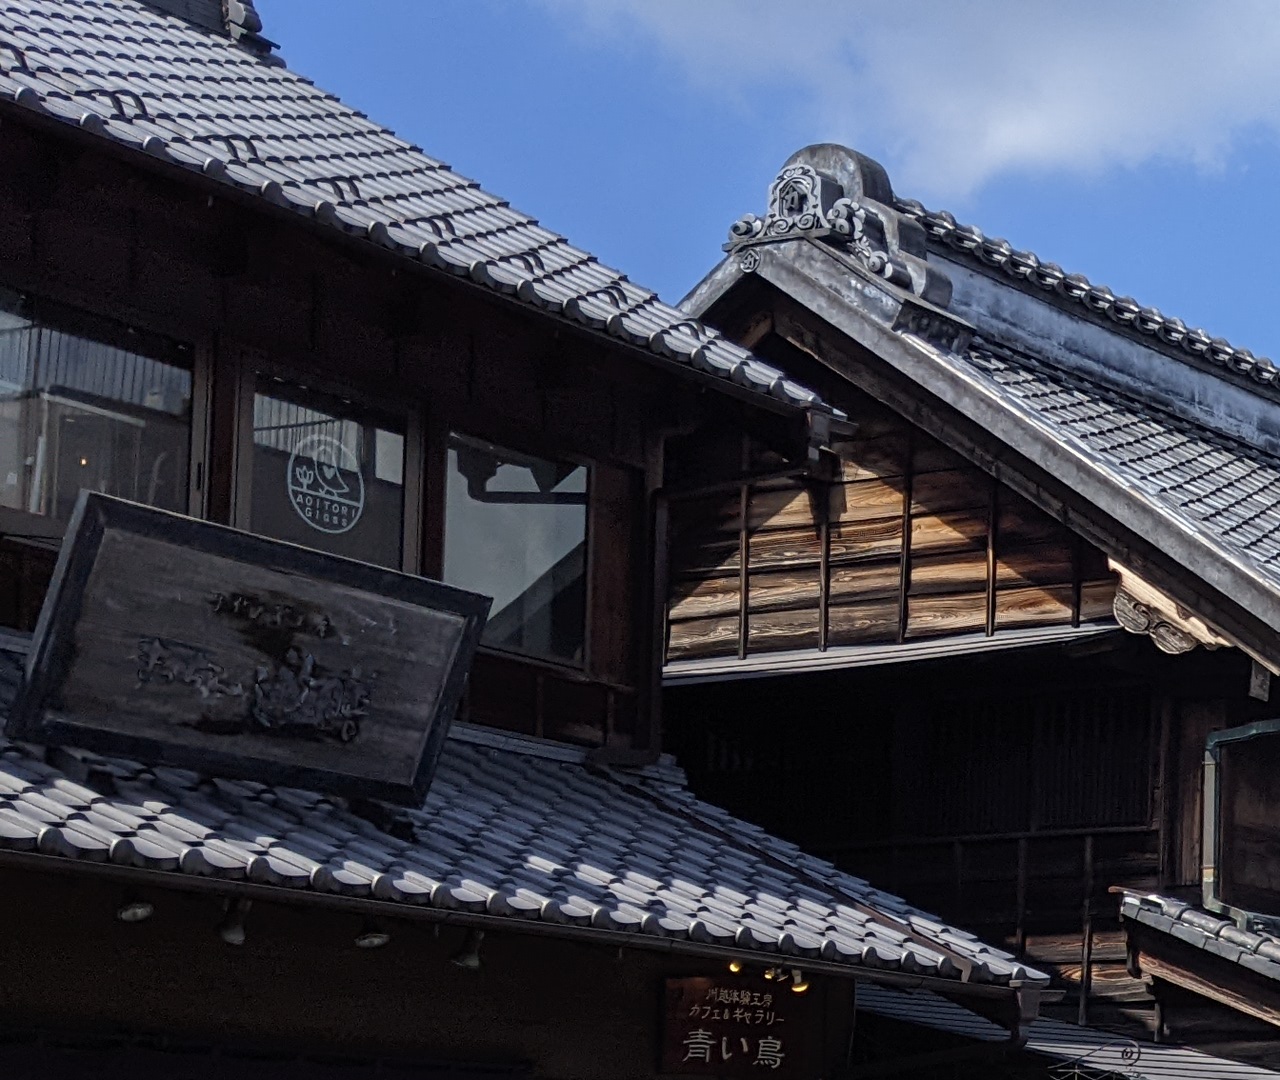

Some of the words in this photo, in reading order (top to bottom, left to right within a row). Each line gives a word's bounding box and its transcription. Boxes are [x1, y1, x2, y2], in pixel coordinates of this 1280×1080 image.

[295, 494, 356, 518] AOITORI
[682, 1028, 786, 1069] 青い鳥
